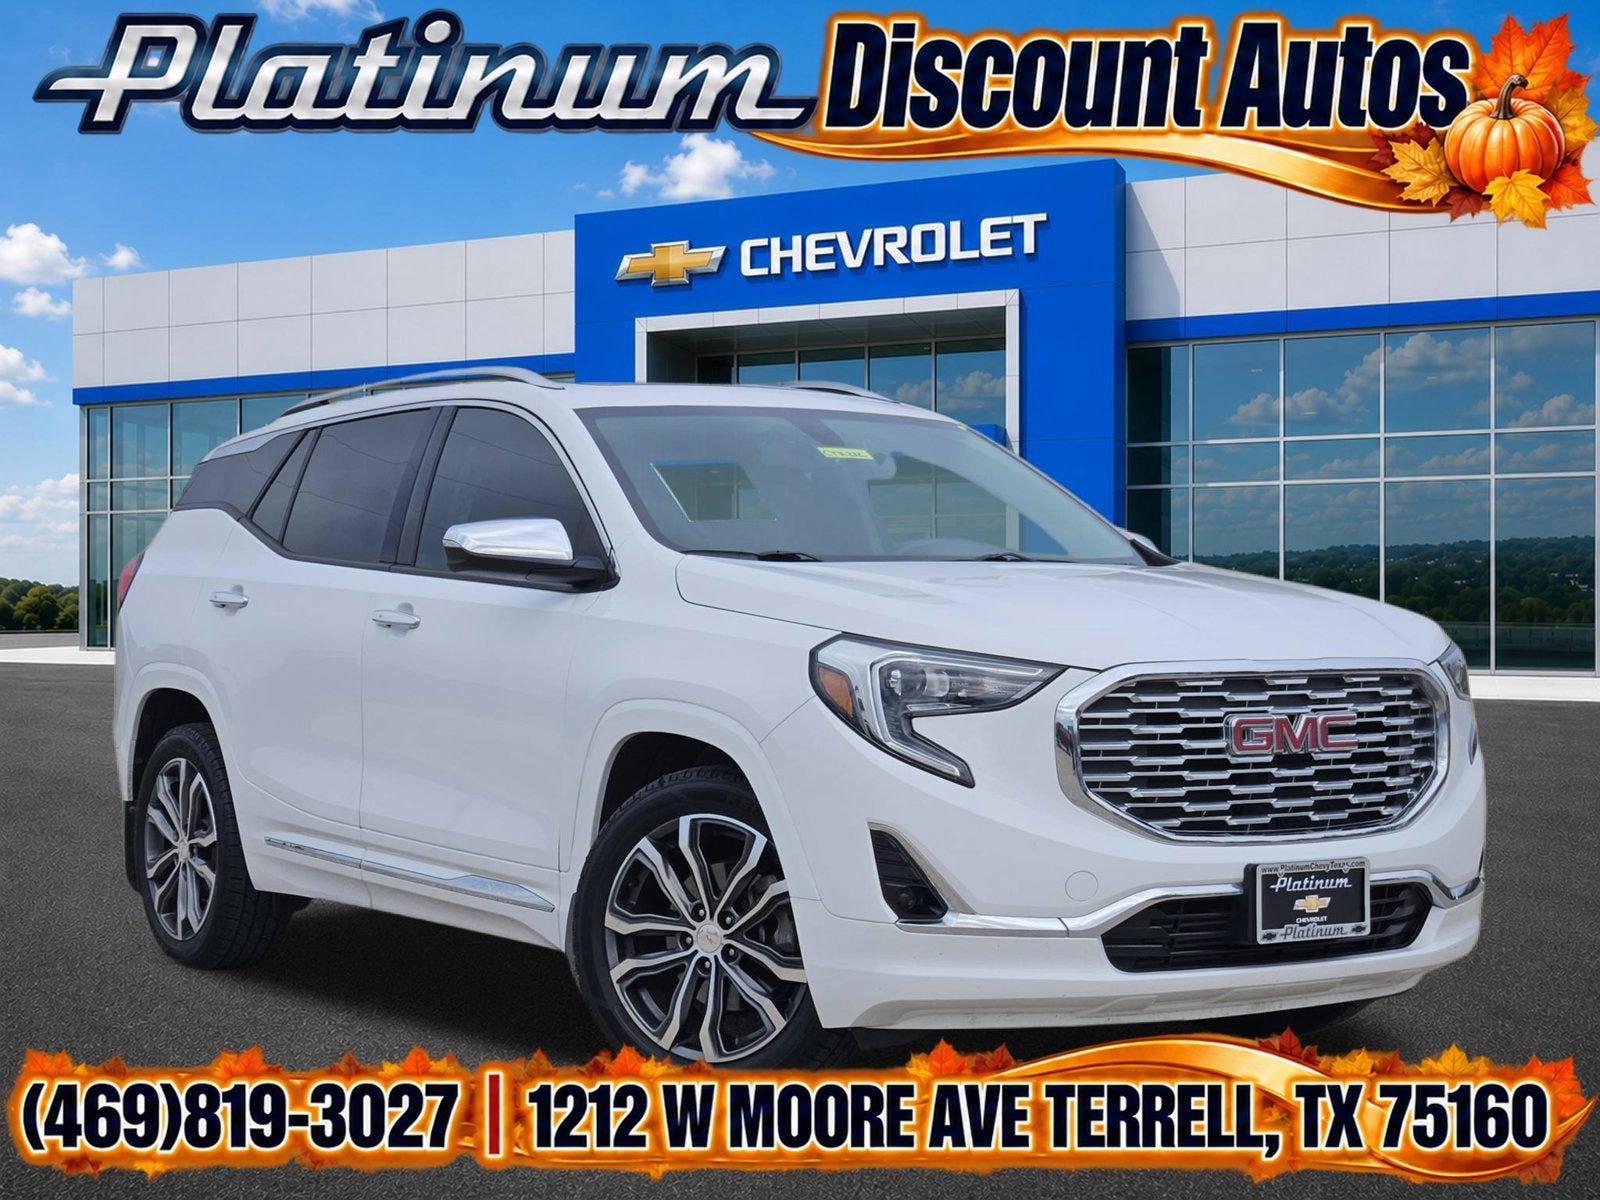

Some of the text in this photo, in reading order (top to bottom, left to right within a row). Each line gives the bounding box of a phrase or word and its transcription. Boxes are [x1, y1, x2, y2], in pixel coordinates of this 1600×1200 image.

[740, 212, 1048, 278] CHEVROLET
[1226, 712, 1359, 756] GMC
[1261, 861, 1365, 873] wwwPlatinumChevyTexas.com
[1270, 875, 1352, 892] Platinum
[1296, 916, 1328, 924] CHEVROLET
[1279, 923, 1348, 940] Platinum
